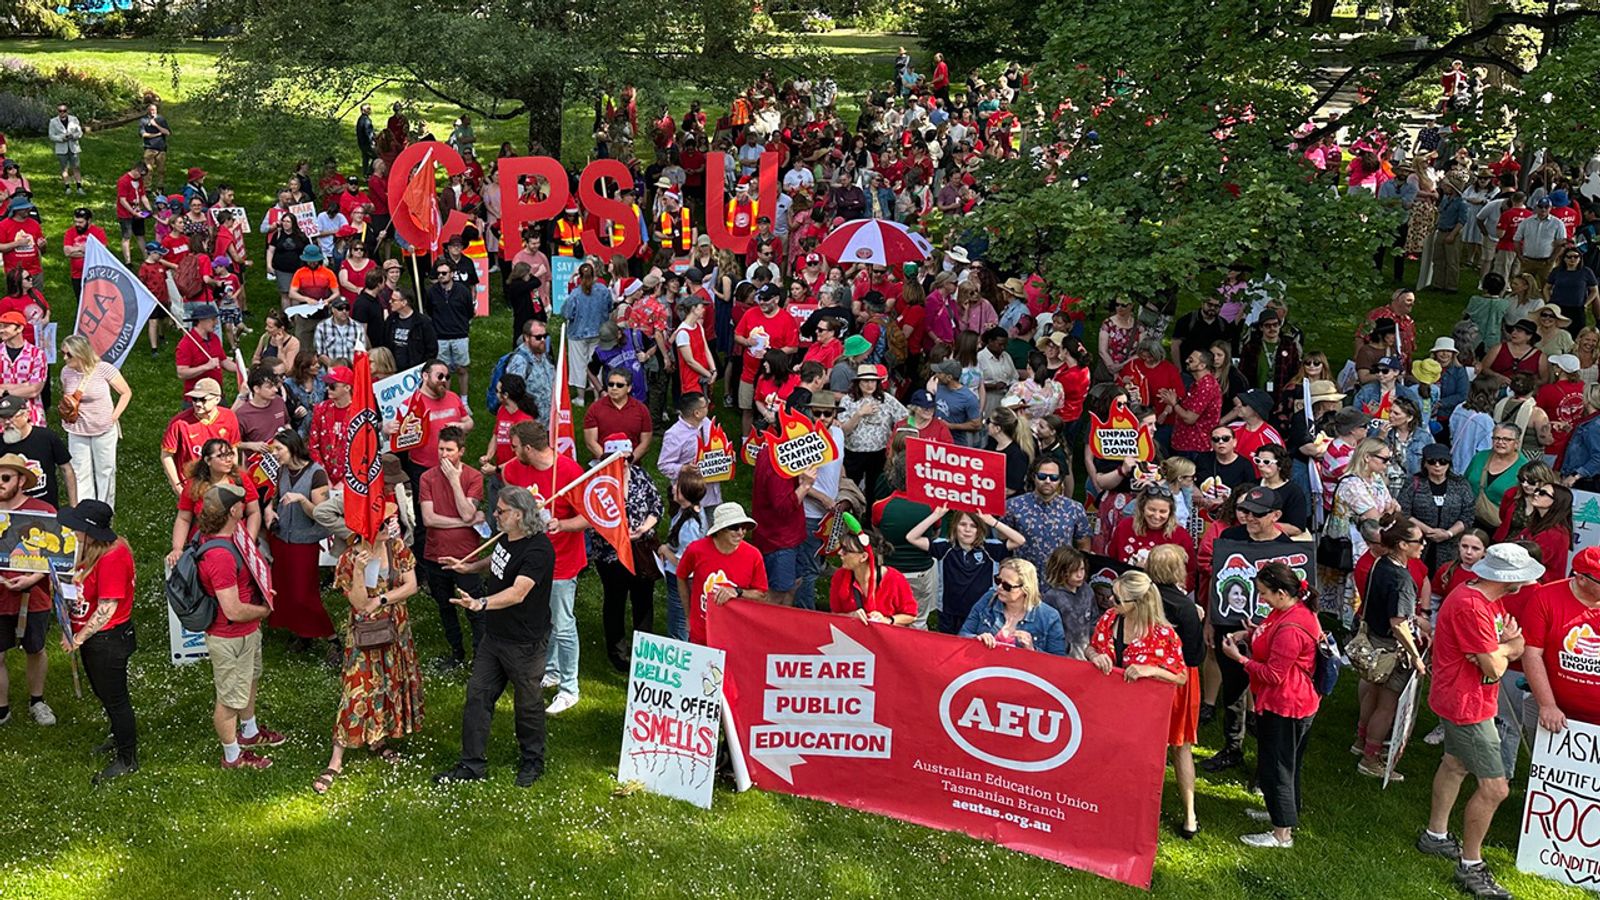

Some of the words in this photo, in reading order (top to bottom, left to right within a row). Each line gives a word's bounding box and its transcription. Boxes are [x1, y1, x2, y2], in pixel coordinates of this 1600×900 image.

[704, 450, 724, 460] RISING
[778, 433, 820, 454] SCHOOL
[779, 441, 826, 466] STAFFING
[925, 443, 984, 471] More
[1103, 447, 1137, 455] DOWN
[702, 465, 728, 476] VIOLENCE
[789, 453, 822, 471] CRISIS
[914, 462, 966, 486] time
[970, 473, 996, 491] to
[593, 485, 621, 519] AEU
[923, 482, 987, 507] teach
[634, 637, 692, 671] JINGLE
[634, 661, 683, 689] BELLS
[775, 661, 813, 678] WE
[817, 661, 866, 679] ARE
[633, 681, 675, 710] YOUR
[680, 695, 721, 722] OFFER
[776, 696, 862, 715] PUBLIC
[632, 709, 714, 759] SMELLS
[957, 697, 1064, 744] AEU
[755, 731, 886, 752] EDUCATION
[912, 759, 982, 783] Australian
[985, 773, 1052, 801] Education
[1055, 792, 1099, 813] Union
[941, 779, 1014, 807] Tasmanian
[1017, 797, 1066, 821] Branch
[952, 798, 1052, 833] aeutas.org.au
